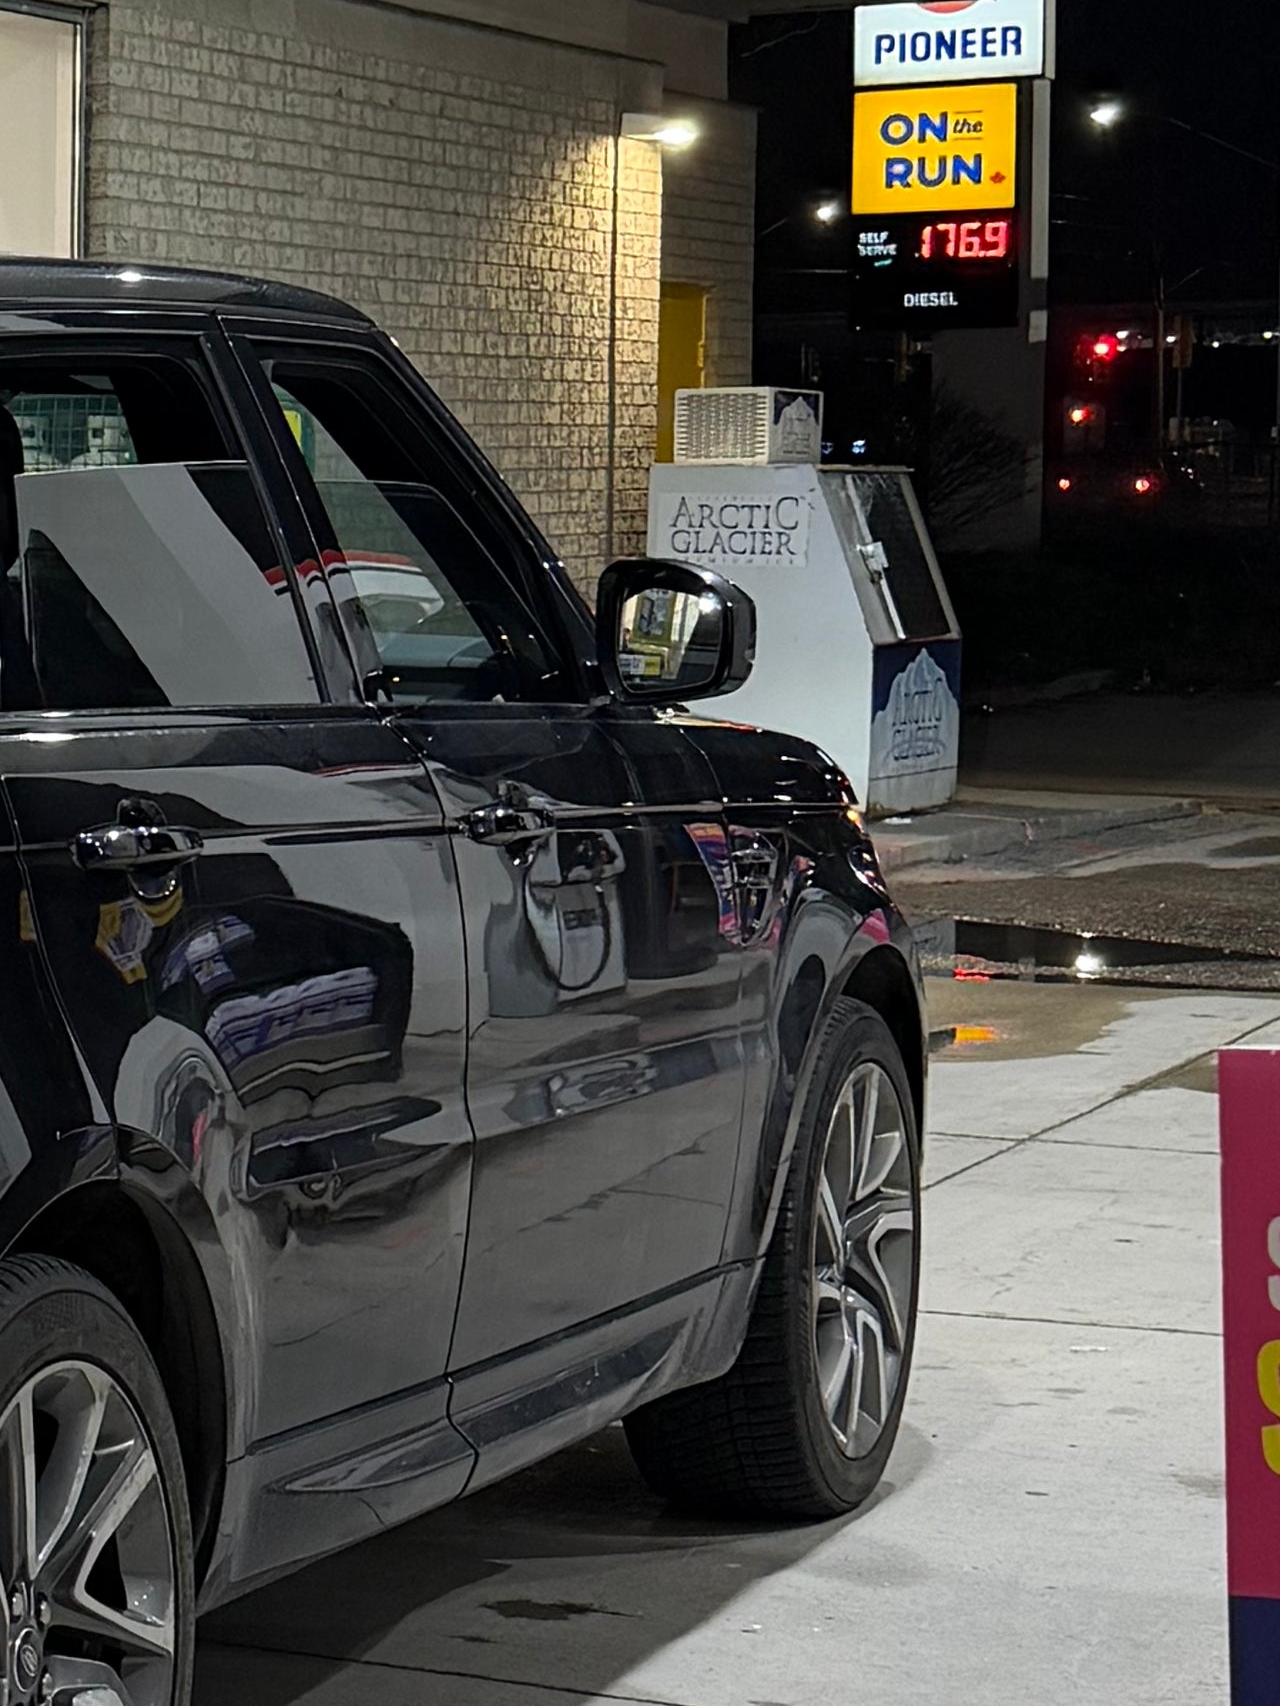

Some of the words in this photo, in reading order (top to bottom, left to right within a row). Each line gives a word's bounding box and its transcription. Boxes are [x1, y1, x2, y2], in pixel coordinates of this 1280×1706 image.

[874, 26, 1022, 65] PIONEER
[880, 111, 948, 145] ON
[952, 117, 984, 134] the
[884, 153, 983, 189] RUN
[857, 243, 897, 257] SERVE
[858, 231, 889, 244] SELF
[903, 291, 958, 307] DIESEL
[669, 495, 800, 530] ARCTIC
[670, 529, 798, 556] GLACIER
